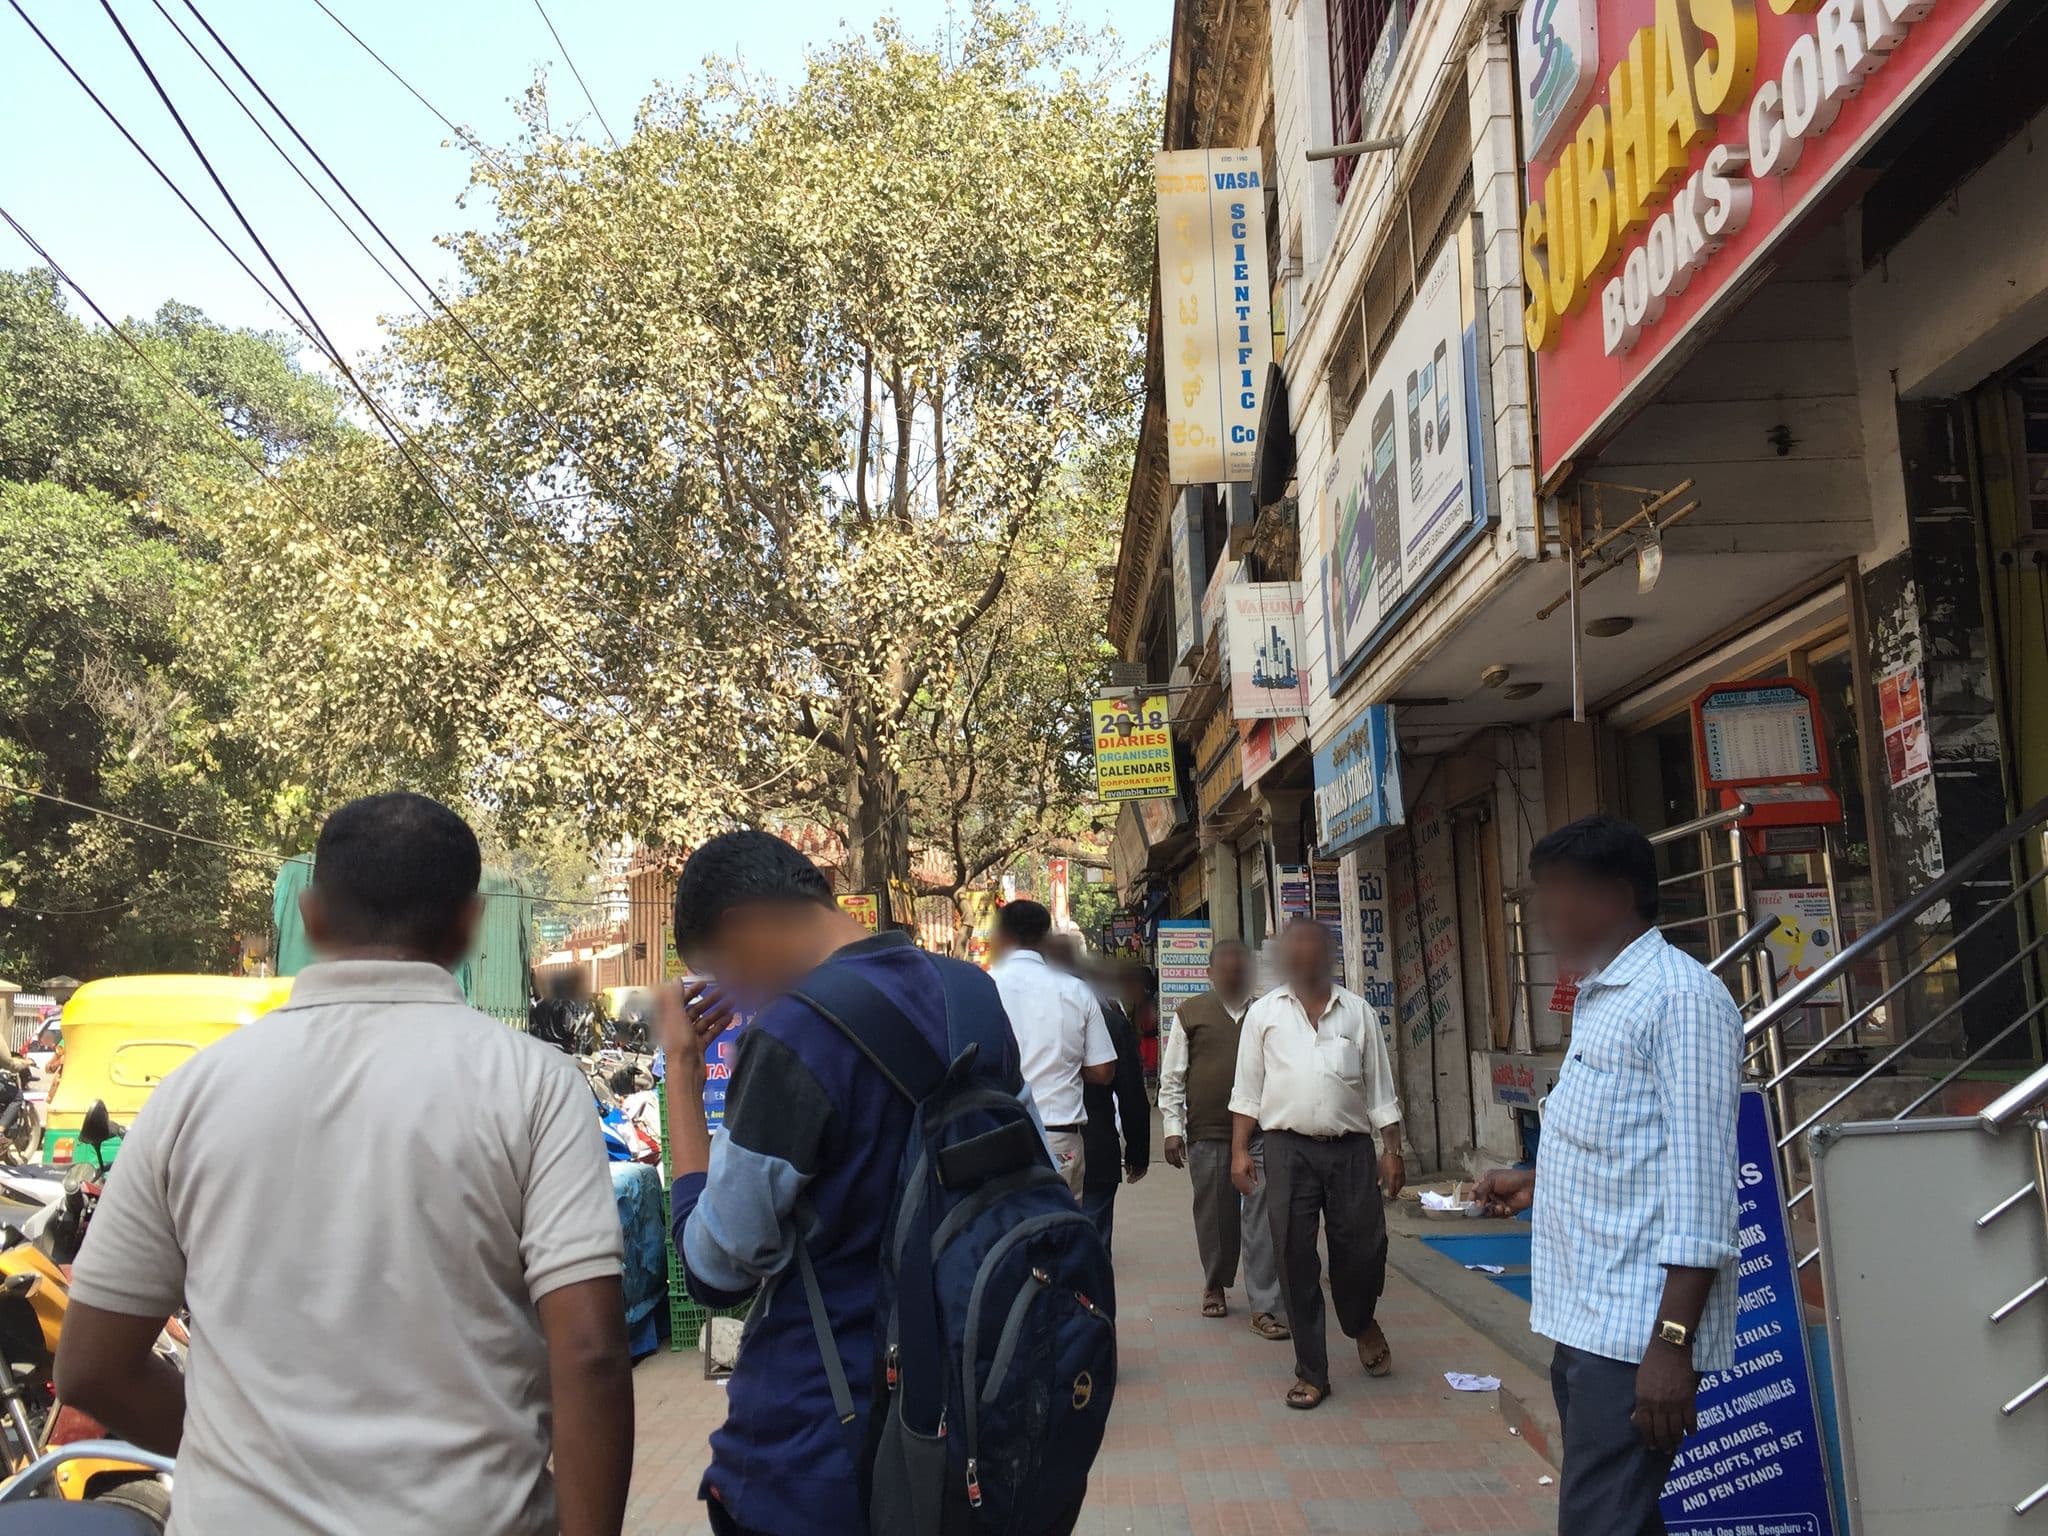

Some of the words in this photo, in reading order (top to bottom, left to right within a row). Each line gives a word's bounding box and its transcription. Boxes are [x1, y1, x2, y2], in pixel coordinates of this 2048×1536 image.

[1214, 171, 1260, 190] VASA
[1524, 0, 1758, 353] SUBHAS
[1602, 144, 1752, 357] BOOKS
[1230, 203, 1256, 409] SCIENTIFIC
[1236, 599, 1304, 615] VARUNA
[1714, 693, 1747, 702] SUPER
[1758, 688, 1793, 698] SCALES
[1098, 733, 1167, 749] DIARIES
[1100, 748, 1169, 762] ORGANISERS
[1100, 762, 1171, 777] CALENDARS
[1100, 779, 1150, 788] CORPORATE
[1152, 775, 1173, 784] GIFT
[1106, 788, 1145, 798] available
[848, 911, 877, 924] 018
[1162, 953, 1188, 965] ACCOUNT
[1189, 952, 1209, 964] BOOKS
[1162, 969, 1182, 977] BOX
[1162, 983, 1188, 992] SPRING
[1190, 983, 1210, 991] FILES
[1736, 1285, 1776, 1316] PMENTS
[1734, 1321, 1782, 1350] ERIALS
[1721, 1370, 1733, 1383] &
[1733, 1350, 1783, 1379] STANDS
[1723, 1402, 1734, 1418] &
[1732, 1378, 1796, 1415] CONSUMABLES
[1685, 1442, 1720, 1464] YEAR
[1720, 1421, 1774, 1450] DIARIES,
[1754, 1442, 1780, 1460] PEN
[1780, 1430, 1804, 1450] SET
[1682, 1492, 1708, 1513] AND
[1708, 1481, 1735, 1502] PEN
[1735, 1462, 1784, 1491] STANDS
[1758, 1521, 1801, 1536] Bengaluru
[1807, 1520, 1814, 1532] 2
